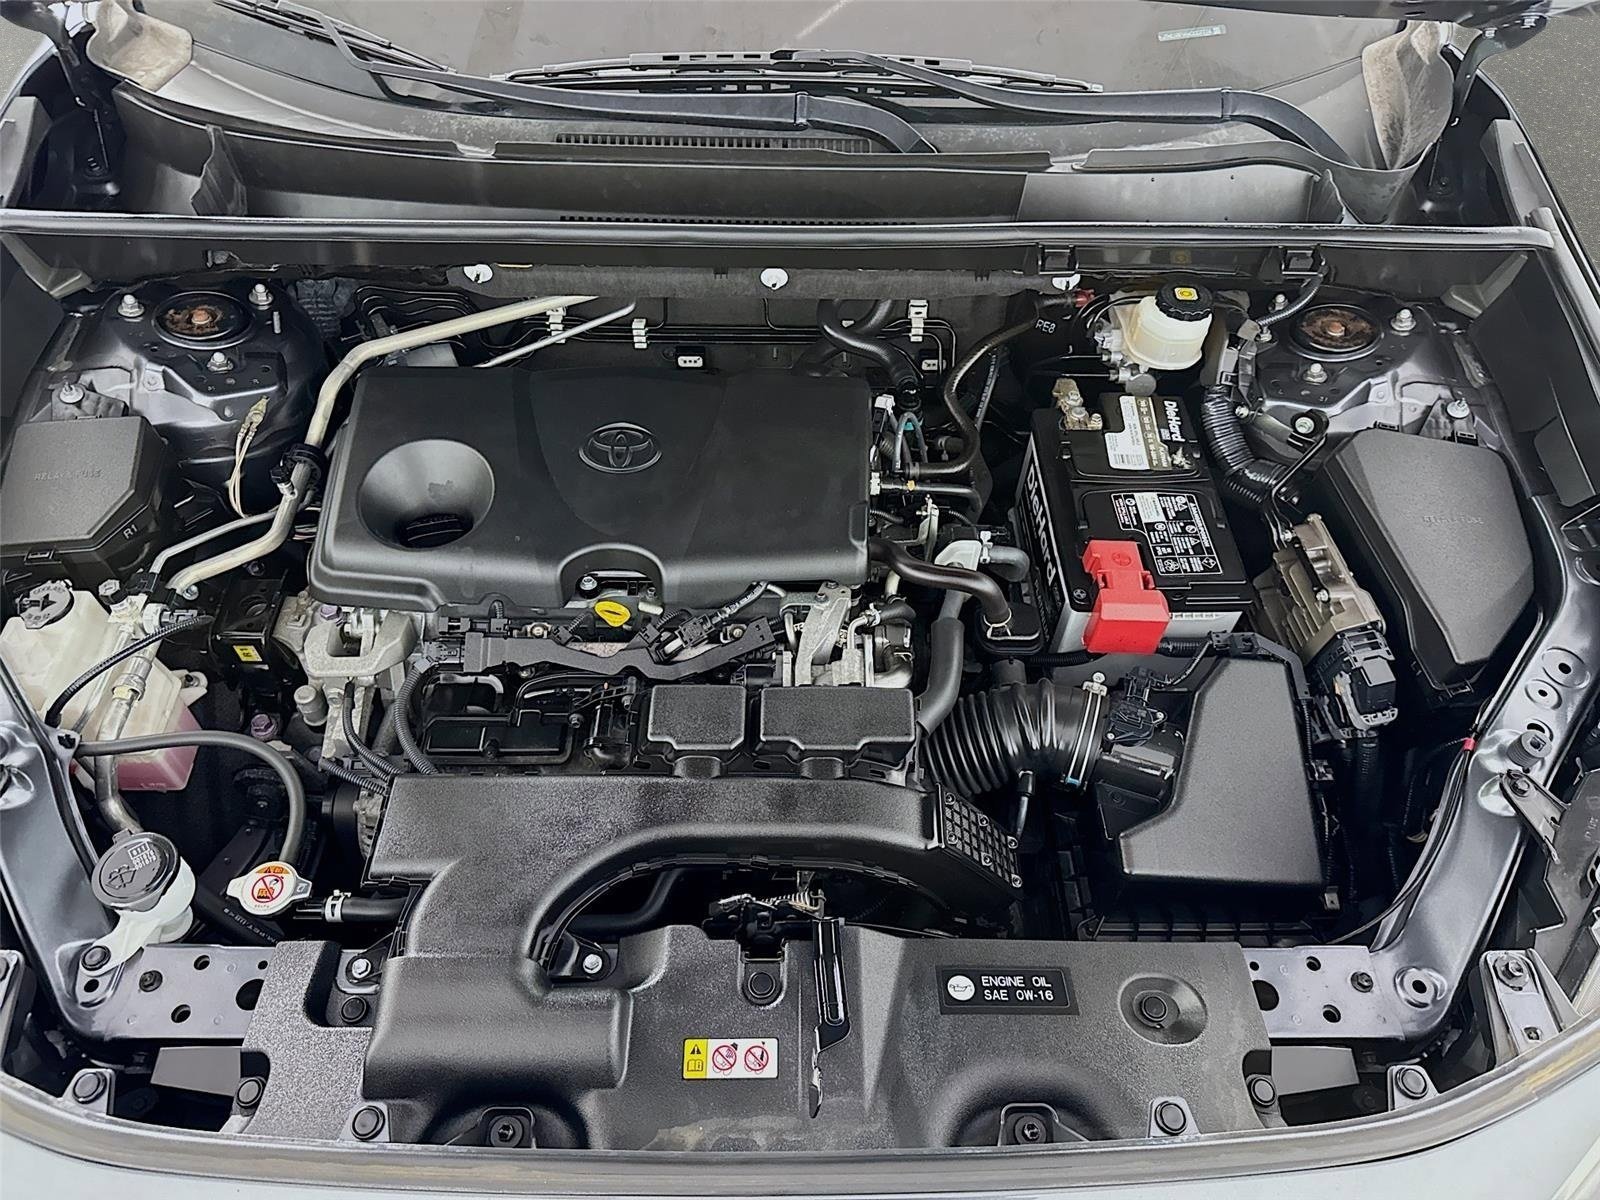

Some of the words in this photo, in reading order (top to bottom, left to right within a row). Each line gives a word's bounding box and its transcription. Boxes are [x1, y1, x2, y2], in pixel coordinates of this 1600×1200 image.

[1163, 400, 1186, 442] DieHard
[123, 524, 138, 539] R1
[1027, 463, 1056, 586] DieHard
[981, 975, 1025, 988] ENGINE
[1032, 976, 1052, 988] OIL
[984, 989, 1009, 1001] SAE
[1016, 989, 1054, 1001] 0W-16
